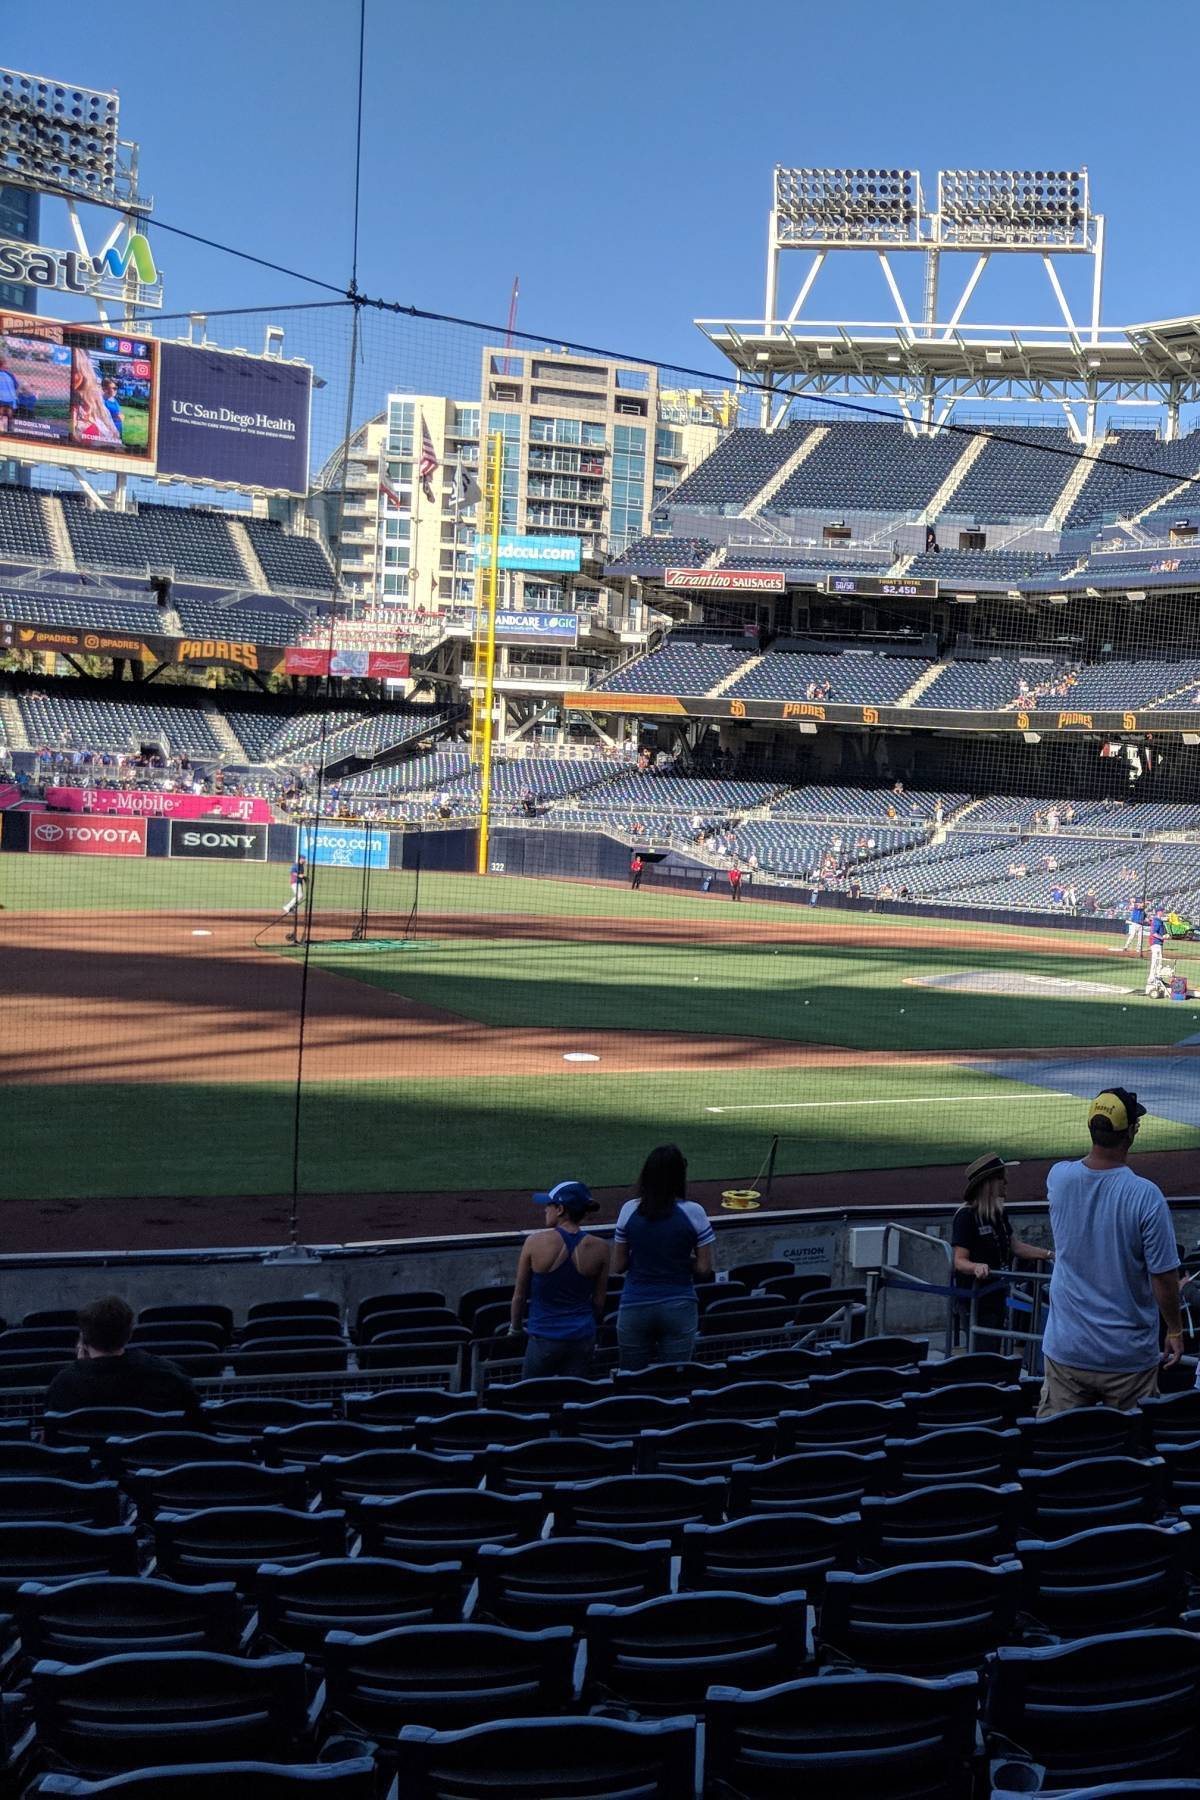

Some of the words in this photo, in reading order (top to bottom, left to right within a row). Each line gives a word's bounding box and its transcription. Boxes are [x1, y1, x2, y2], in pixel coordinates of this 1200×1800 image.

[172, 400, 193, 416] UC
[194, 404, 218, 420] San
[220, 408, 255, 427] Diego
[256, 414, 296, 432] Health
[668, 570, 731, 587] Tarantino
[733, 577, 782, 589] SAUSAGES
[36, 633, 79, 645] @PADRES
[101, 638, 140, 650] @PADRES
[178, 640, 258, 670] PADRES
[783, 703, 826, 720] PADRES
[1058, 712, 1093, 729] PADRES
[66, 827, 141, 844] TOYOTA
[184, 831, 256, 848] SONY
[304, 834, 382, 852] petco.com
[491, 862, 505, 872] 322
[783, 1247, 825, 1258] CAUTION
